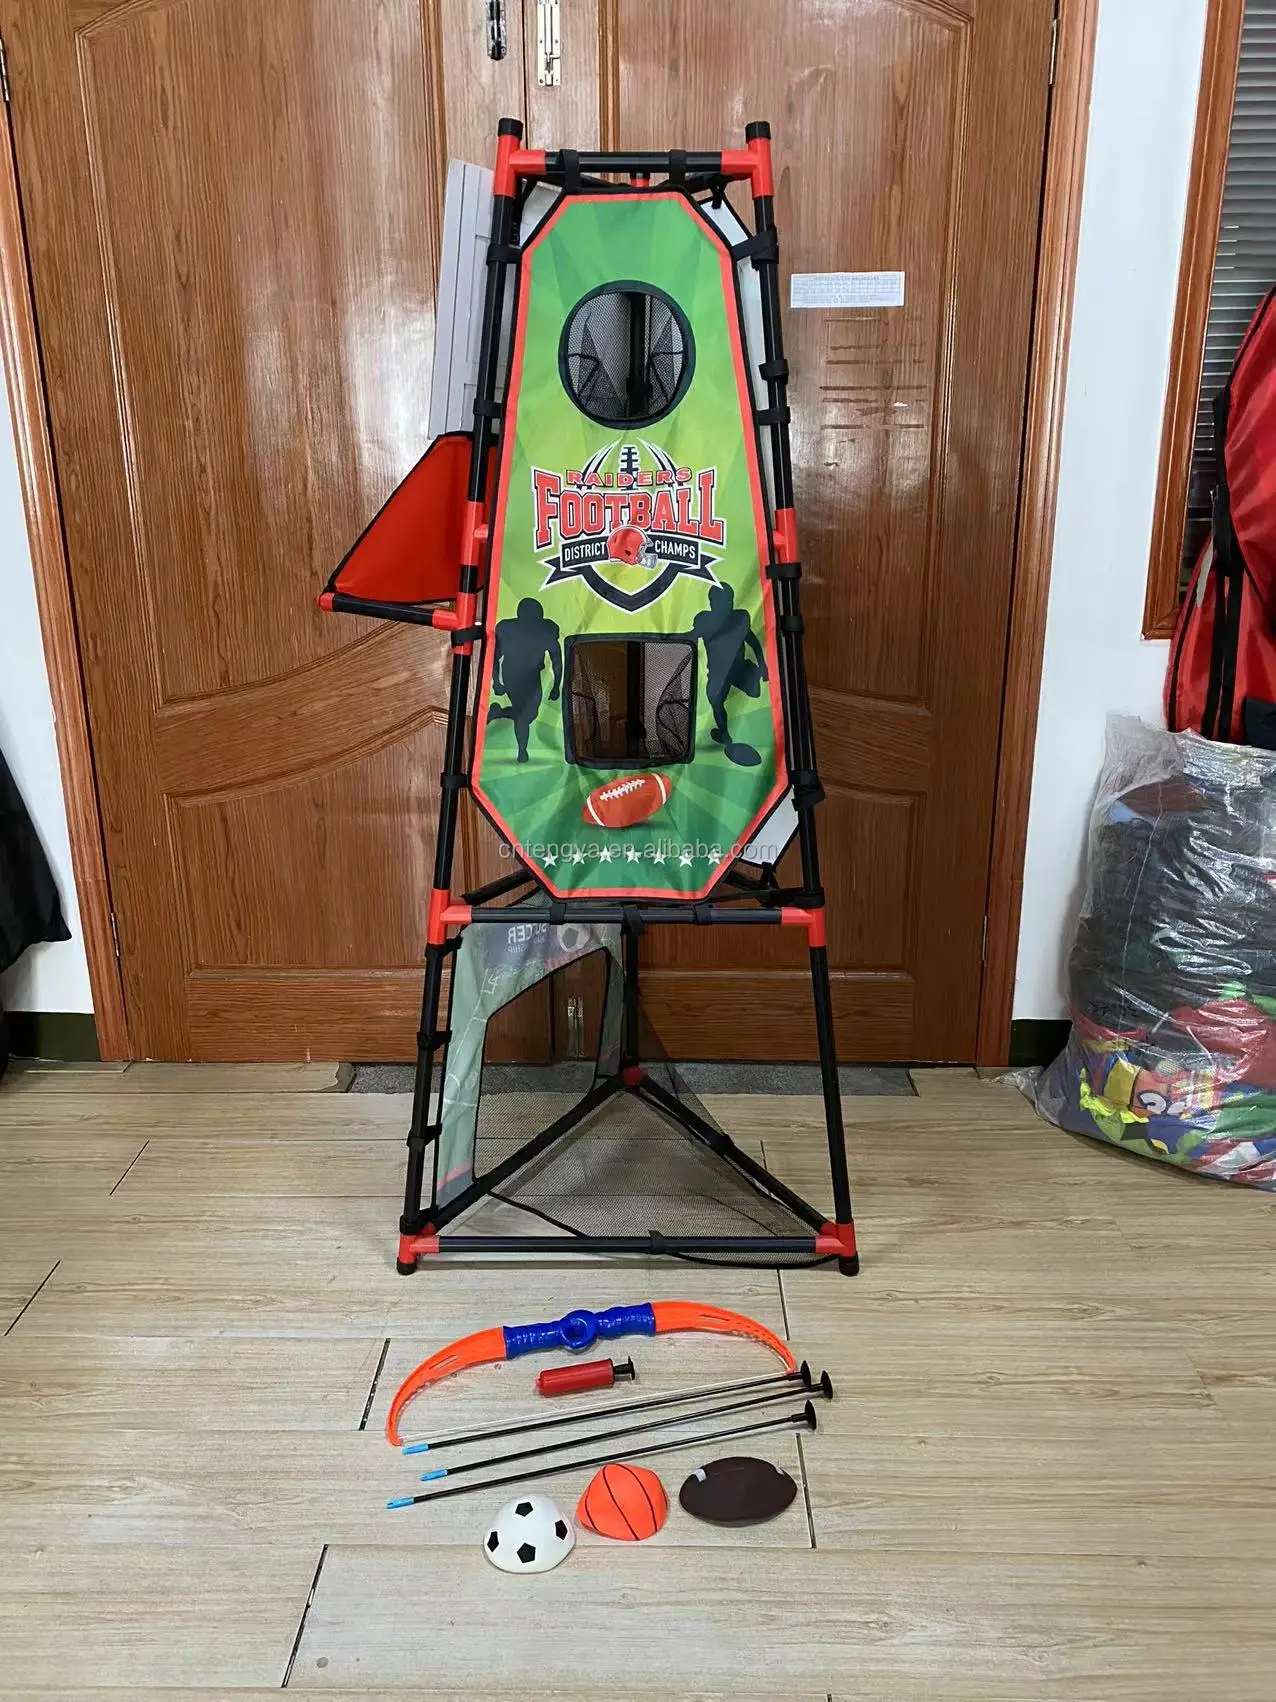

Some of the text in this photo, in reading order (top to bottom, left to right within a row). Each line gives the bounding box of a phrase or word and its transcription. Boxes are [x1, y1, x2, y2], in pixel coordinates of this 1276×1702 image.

[566, 467, 692, 487] RAIDERS
[533, 468, 725, 549] FOOTBALL
[564, 540, 696, 561] DISTRICT CHAMPS
